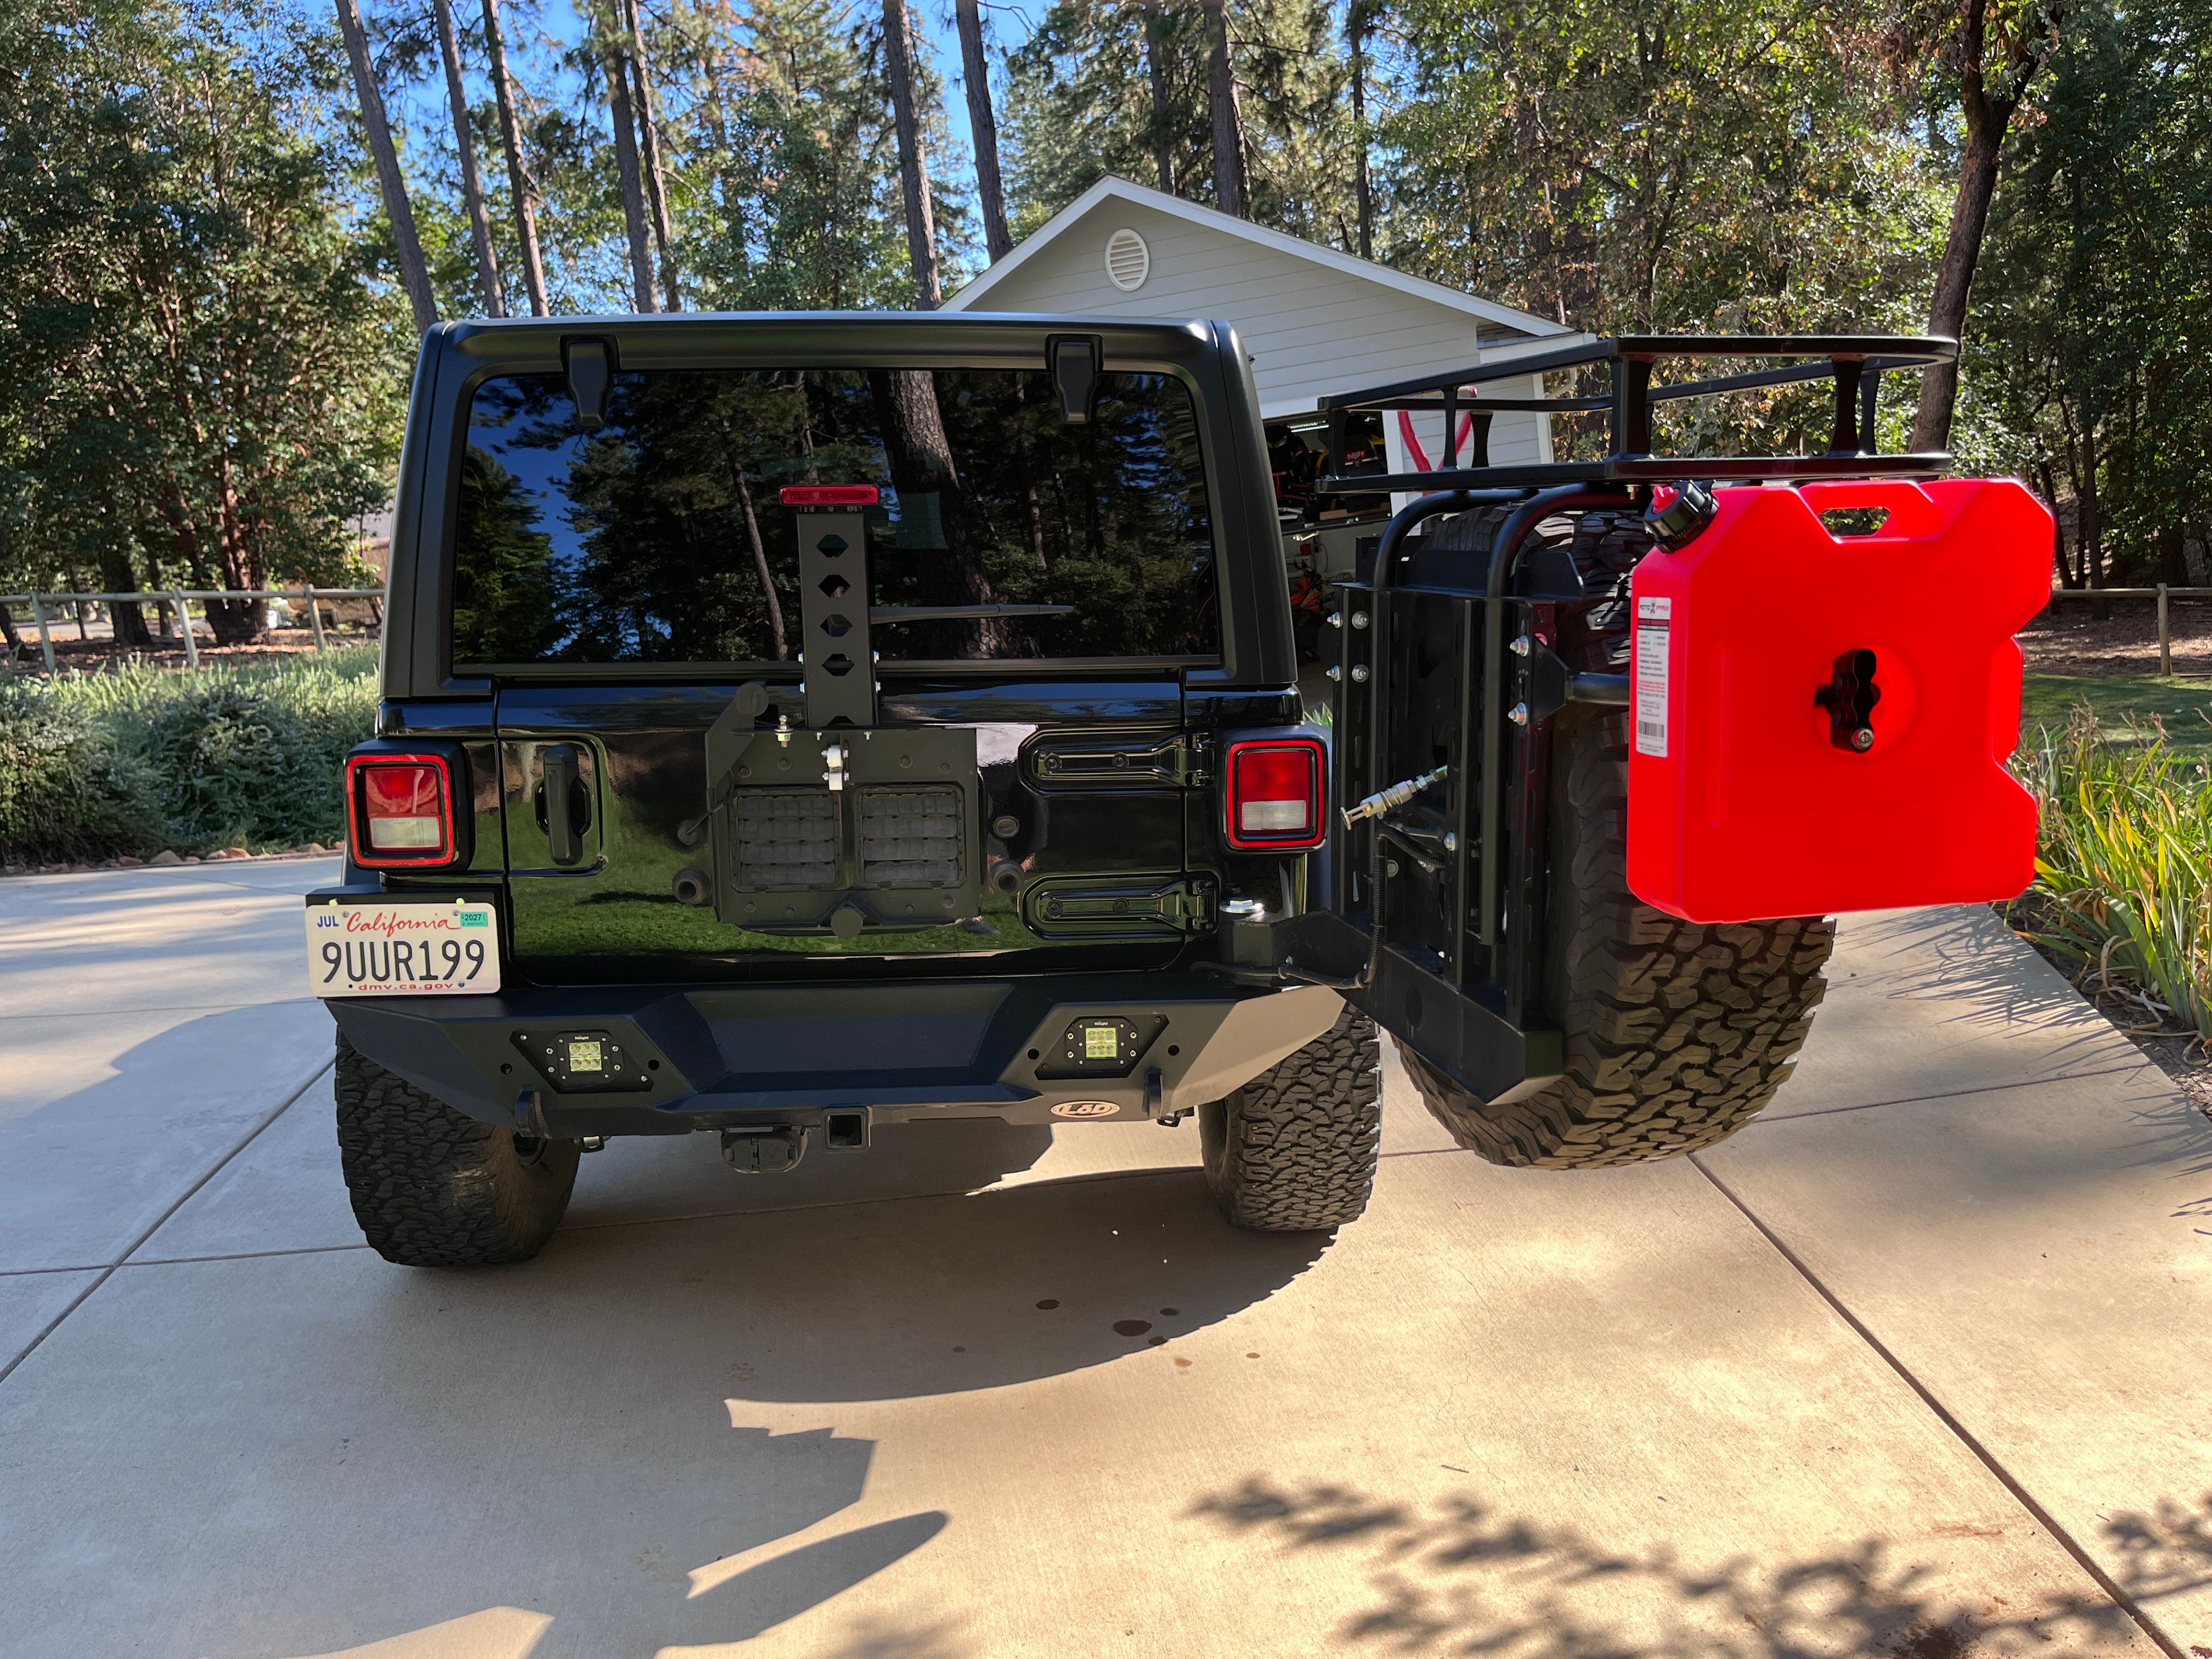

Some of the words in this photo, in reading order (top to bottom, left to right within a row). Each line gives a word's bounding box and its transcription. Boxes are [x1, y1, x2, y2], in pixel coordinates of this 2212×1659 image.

[317, 915, 339, 928] JUL
[346, 912, 461, 938] California
[322, 939, 484, 983] 9UUR199
[358, 983, 454, 991] dmv.ca.gov
